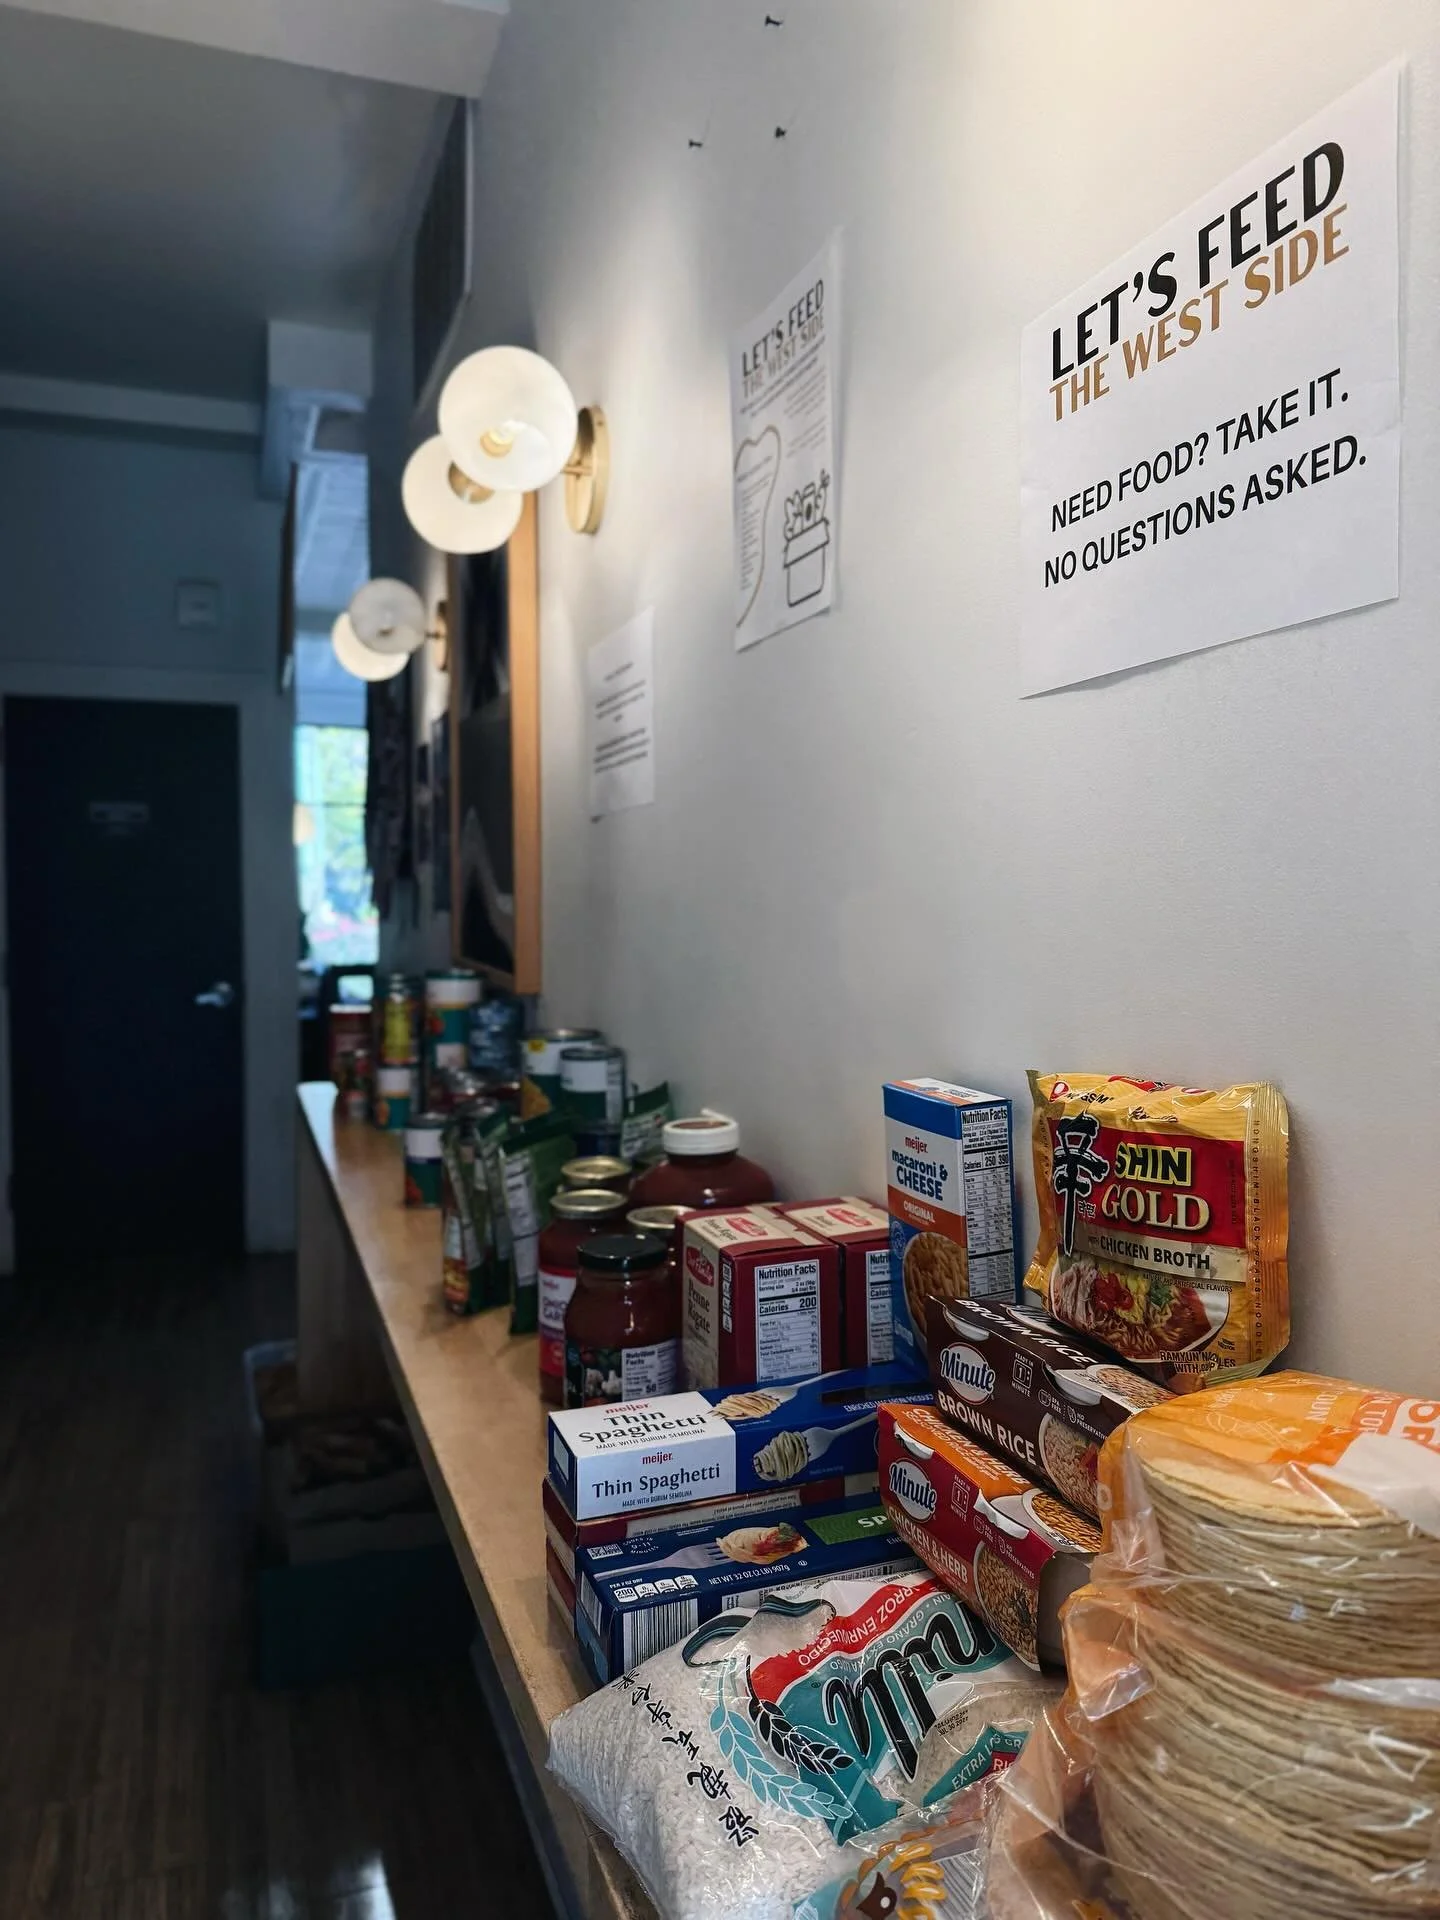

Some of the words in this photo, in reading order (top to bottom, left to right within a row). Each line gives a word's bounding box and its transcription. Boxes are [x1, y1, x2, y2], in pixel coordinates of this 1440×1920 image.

[1052, 252, 1176, 382] LET'S
[1199, 141, 1345, 289] FEED
[1048, 351, 1110, 422] THE
[1123, 278, 1229, 380] WEST
[1243, 203, 1350, 311] SIDE
[742, 319, 784, 377] LET'S
[788, 278, 824, 337] FEED
[767, 335, 797, 378] WEST
[800, 305, 824, 344] SIDE
[1050, 479, 1113, 533] NEED
[1117, 431, 1209, 503] FOOD?
[1215, 387, 1300, 457] TAKE
[1307, 367, 1350, 415] IT.
[1043, 550, 1077, 588] NO
[1082, 483, 1235, 572] QUESTIONS
[1241, 433, 1368, 514] ASKED.
[962, 1110, 989, 1124] Nutrition
[989, 1107, 1008, 1121] Facts
[905, 1136, 928, 1153] meijer
[891, 1149, 937, 1178] macaroni
[939, 1164, 948, 1182] &
[985, 1155, 996, 1167] 250
[1114, 1142, 1193, 1187] SHIN
[896, 1165, 943, 1201] CHEESE
[903, 1200, 935, 1223] ORIGINAL
[1101, 1184, 1211, 1231] GOLD
[870, 1253, 889, 1265] Nutri
[1100, 1235, 1149, 1261] CHICKEN
[1153, 1247, 1211, 1270] BROTH
[759, 1267, 793, 1280] Nutrition
[794, 1263, 816, 1276] Facts
[1206, 1282, 1234, 1293] FLAVORS
[760, 1303, 789, 1314] Calories
[800, 1296, 817, 1308] 200
[955, 1299, 1043, 1338] BROWN
[1031, 1336, 1099, 1364] RICE
[941, 1349, 995, 1391] Minute
[1015, 1352, 1029, 1364] READY
[1160, 1351, 1199, 1362] RAMYUN
[1175, 1362, 1199, 1374] WITH
[1011, 1381, 1031, 1397] MINUTE
[603, 1410, 666, 1426] Thin
[605, 1402, 650, 1415] meijer
[1051, 1403, 1062, 1414] FREE
[1076, 1412, 1085, 1421] NO
[578, 1414, 707, 1443] Spaghetti
[596, 1442, 617, 1450] MADE
[619, 1438, 639, 1448] WITH
[641, 1434, 668, 1444] DURUM
[668, 1428, 706, 1440] SEMOLINA
[936, 1391, 995, 1446] BROWN
[997, 1424, 1037, 1466] RICE
[642, 1452, 673, 1465] meijer
[912, 1408, 976, 1449] CHICKEN
[982, 1453, 1031, 1485] HERB
[592, 1479, 633, 1498] Thin
[639, 1463, 721, 1494] Spaghetti
[890, 1464, 936, 1511] Minute
[622, 1498, 636, 1508] MADE
[636, 1496, 650, 1506] WITH
[650, 1493, 668, 1504] DURUM
[669, 1490, 692, 1501] SEMOLINA
[888, 1506, 930, 1549] CHICKEN
[931, 1539, 939, 1560] &
[940, 1547, 968, 1584] HERB
[708, 1576, 722, 1585] NET
[721, 1574, 733, 1583] WT
[734, 1572, 743, 1581] 32
[752, 1568, 760, 1578] (2
[760, 1566, 772, 1577] LB)
[772, 1564, 791, 1576] 907g
[1006, 1550, 1035, 1580] PRESERVATIVES
[616, 1587, 632, 1597] 200
[887, 1610, 924, 1644] GRANO
[951, 1751, 986, 1791] EXTRA
